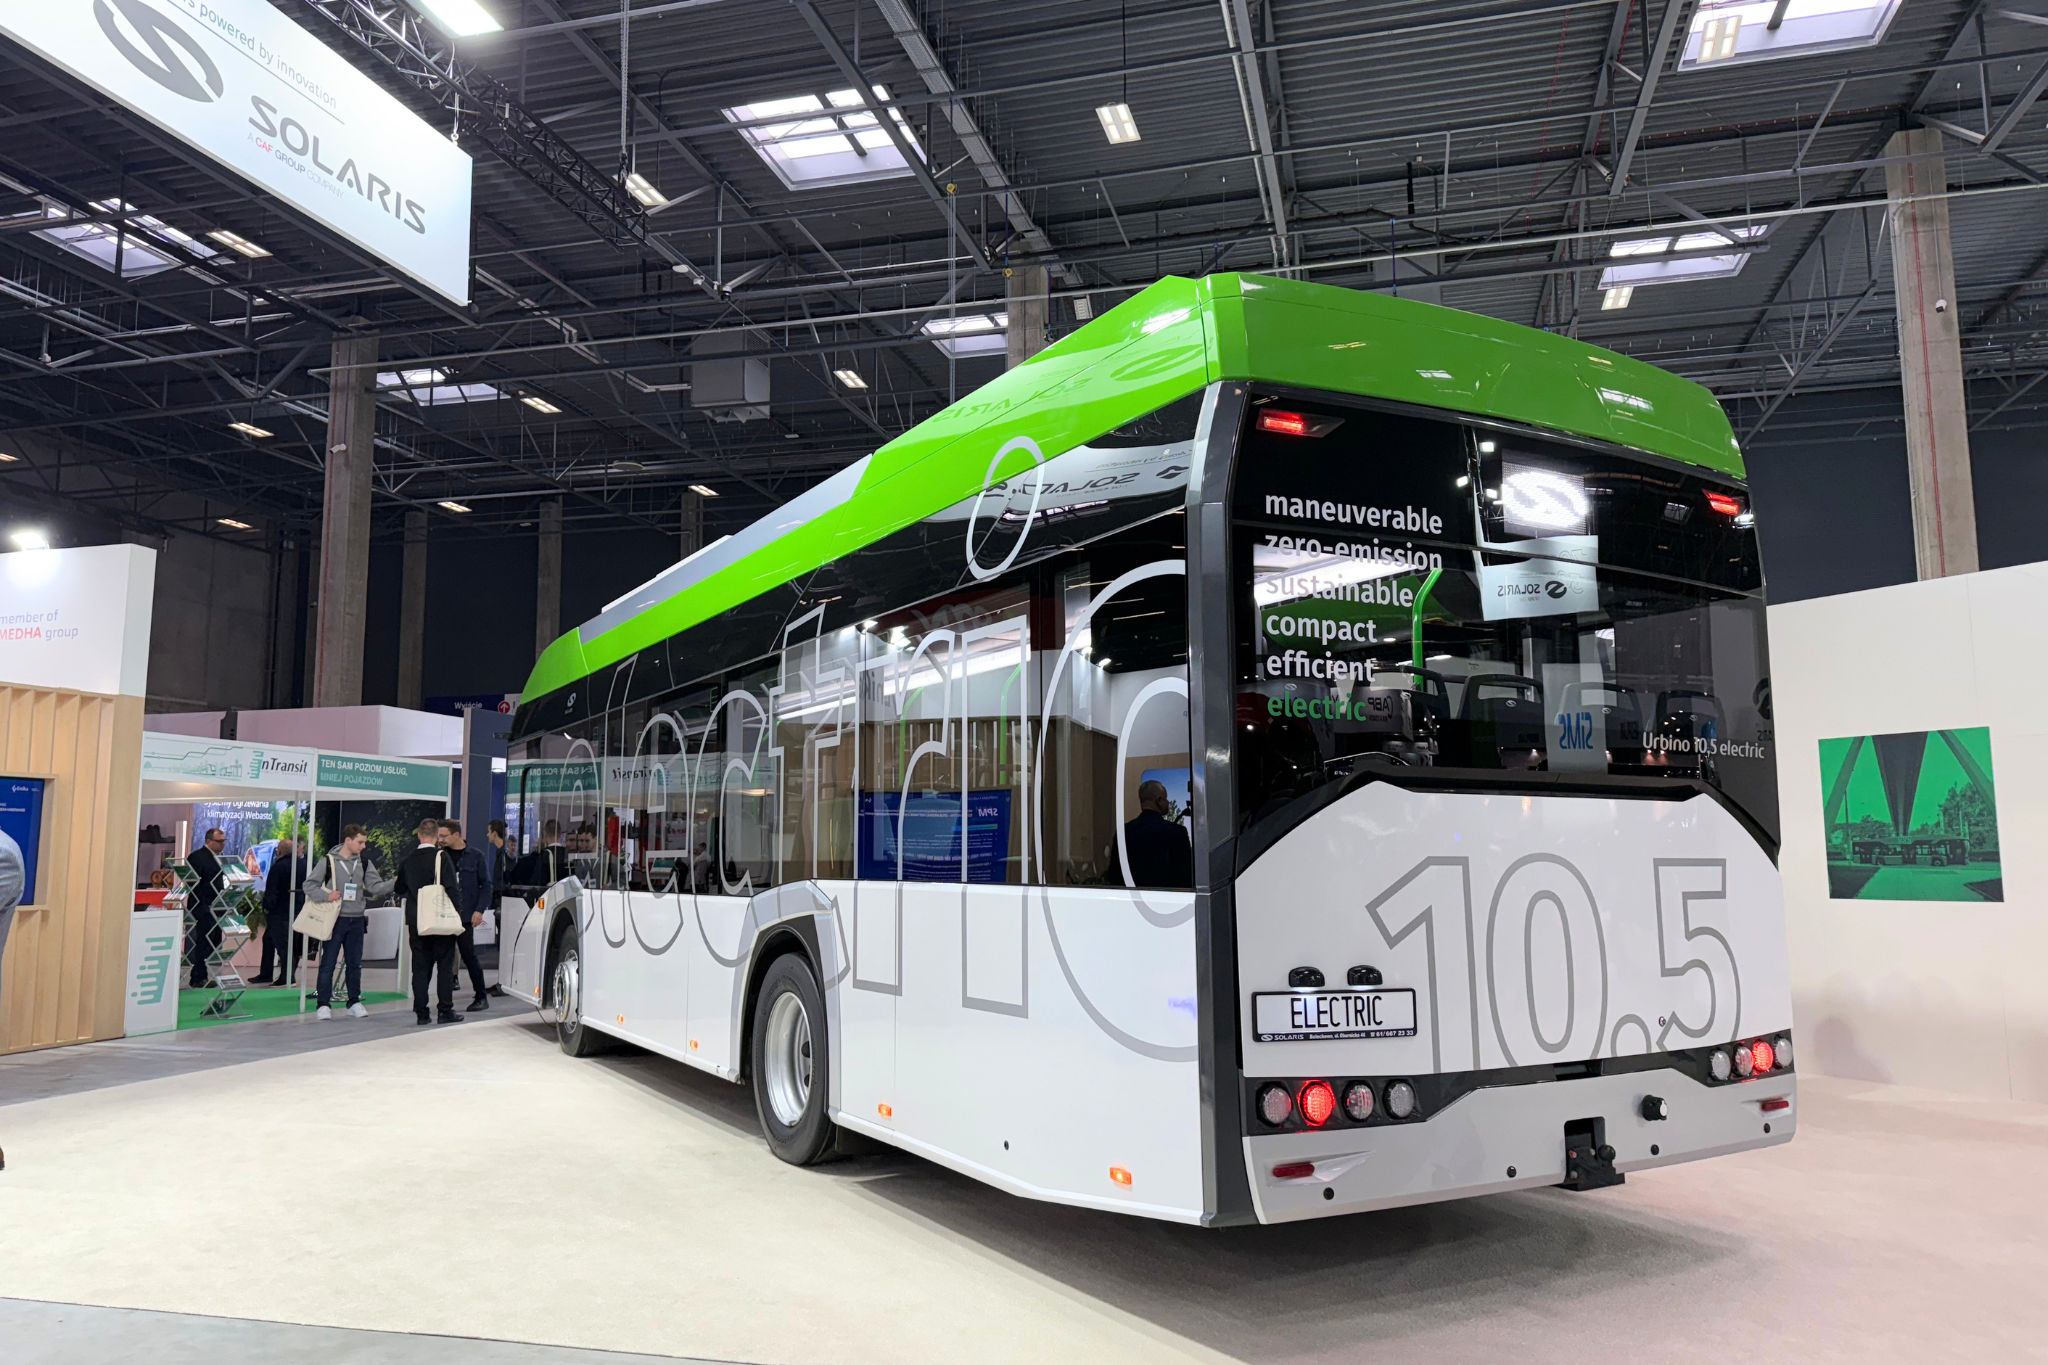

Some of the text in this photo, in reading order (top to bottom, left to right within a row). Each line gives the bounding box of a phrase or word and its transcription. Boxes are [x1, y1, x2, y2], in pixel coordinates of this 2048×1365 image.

[199, 7, 337, 109] powered by innovation
[247, 132, 345, 199] A CAF GROUP COMPANY
[248, 95, 426, 235] SOLARIS
[1265, 494, 1443, 535] maneuverable
[1265, 535, 1443, 572] zero-emission
[1265, 574, 1414, 608] sustainable
[0, 609, 59, 624] member of
[1266, 614, 1378, 646] compact
[0, 626, 79, 642] MEDHA group
[1266, 649, 1376, 682] efficient
[1267, 691, 1367, 721] electric
[1643, 732, 1765, 759] Urbino 10,5 electric
[320, 772, 343, 783] MNIEJ
[343, 773, 384, 786] POJAZDÓW
[321, 759, 408, 777] TEN SAM POZIOM USŁUG,
[206, 810, 245, 820] klimatyzacji
[245, 811, 273, 820] Webasto
[1365, 852, 1742, 1074] 10.5
[1290, 995, 1383, 1029] ELECTRIC
